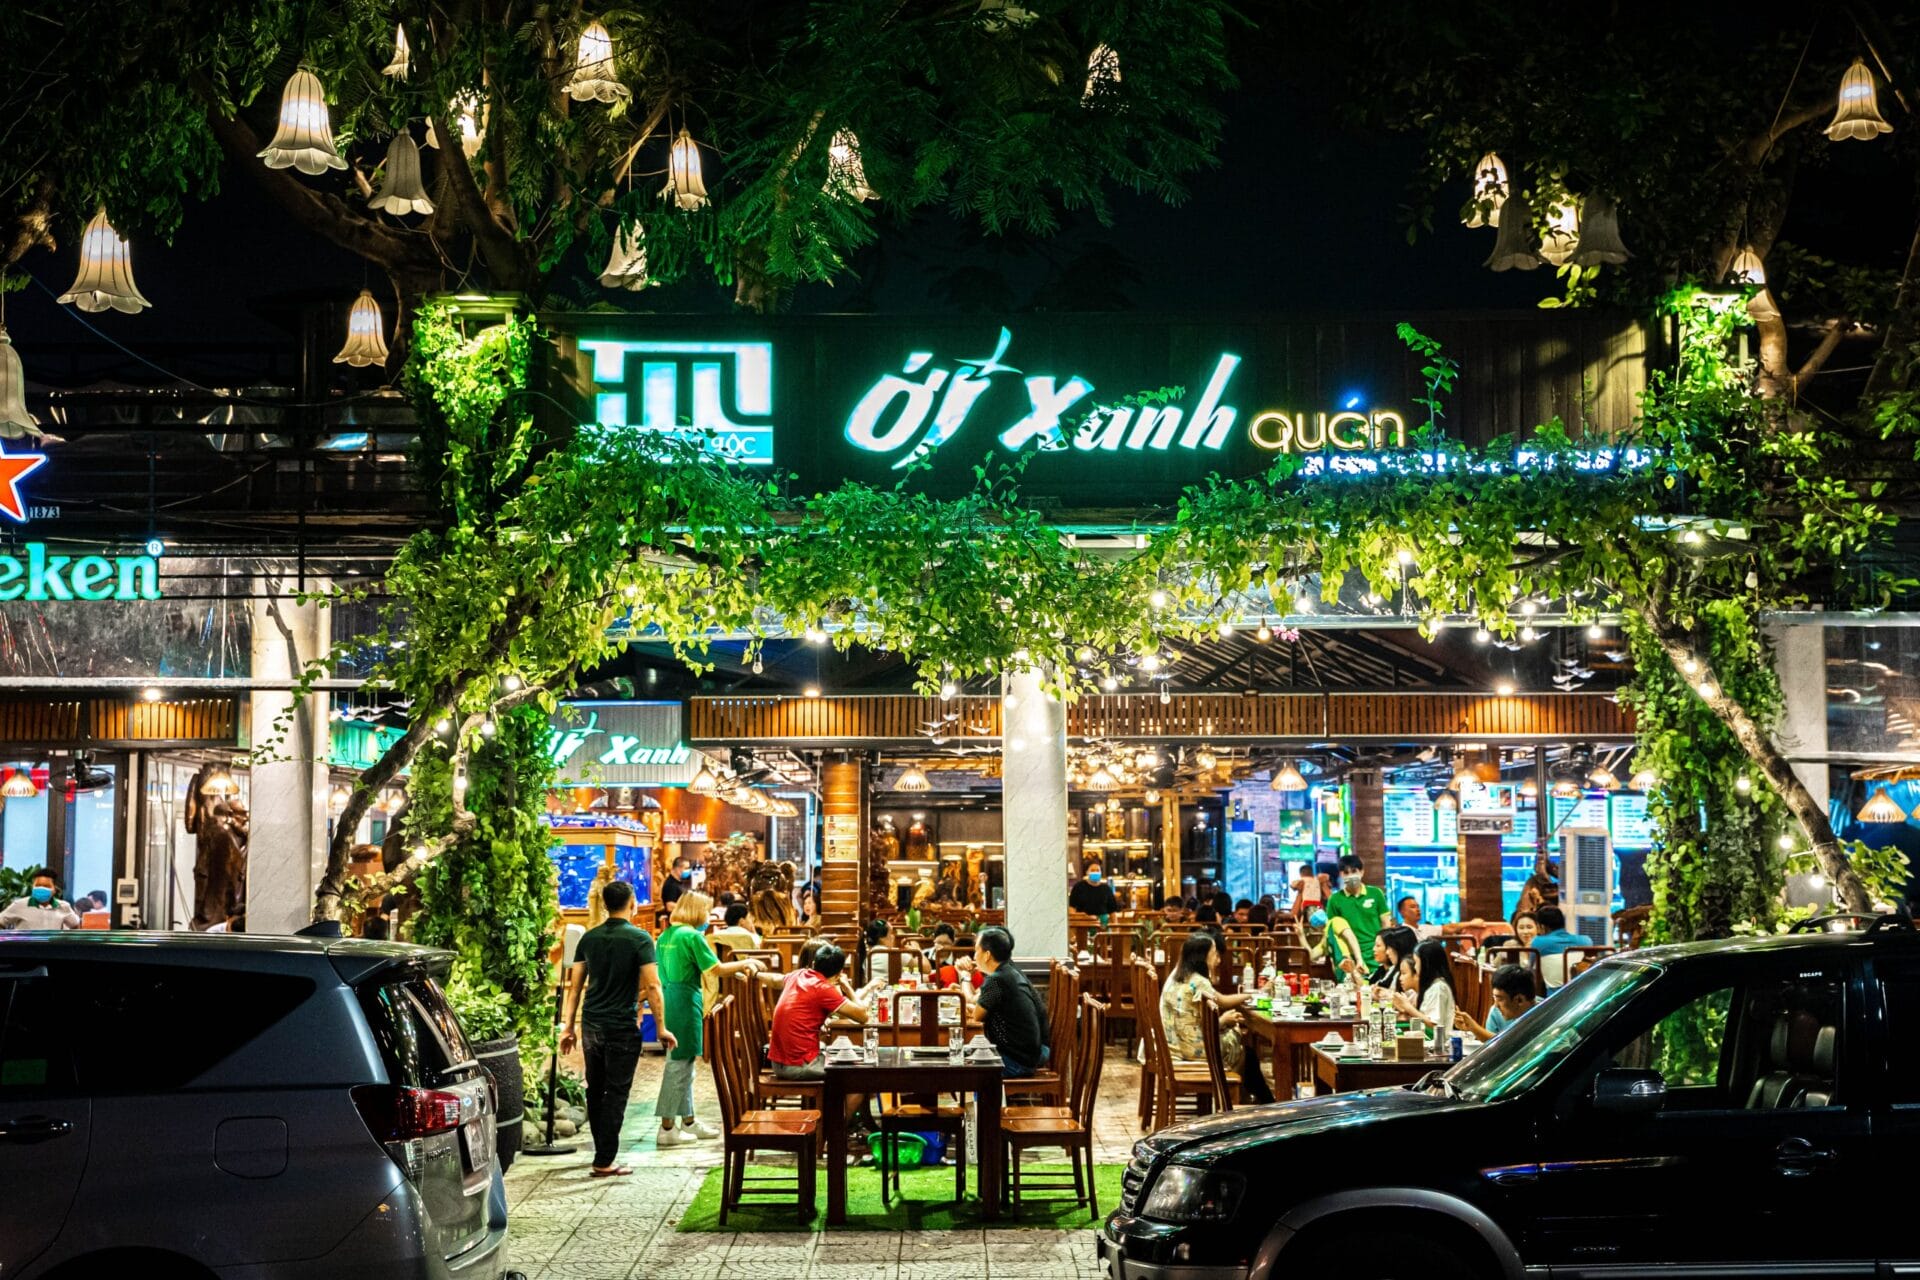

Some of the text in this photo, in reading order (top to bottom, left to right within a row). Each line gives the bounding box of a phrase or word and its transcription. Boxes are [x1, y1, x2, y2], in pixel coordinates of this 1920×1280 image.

[998, 353, 1241, 452] Xanh
[1251, 397, 1405, 454] quán
[32, 506, 58, 518] 1873
[600, 735, 691, 764] Xanh
